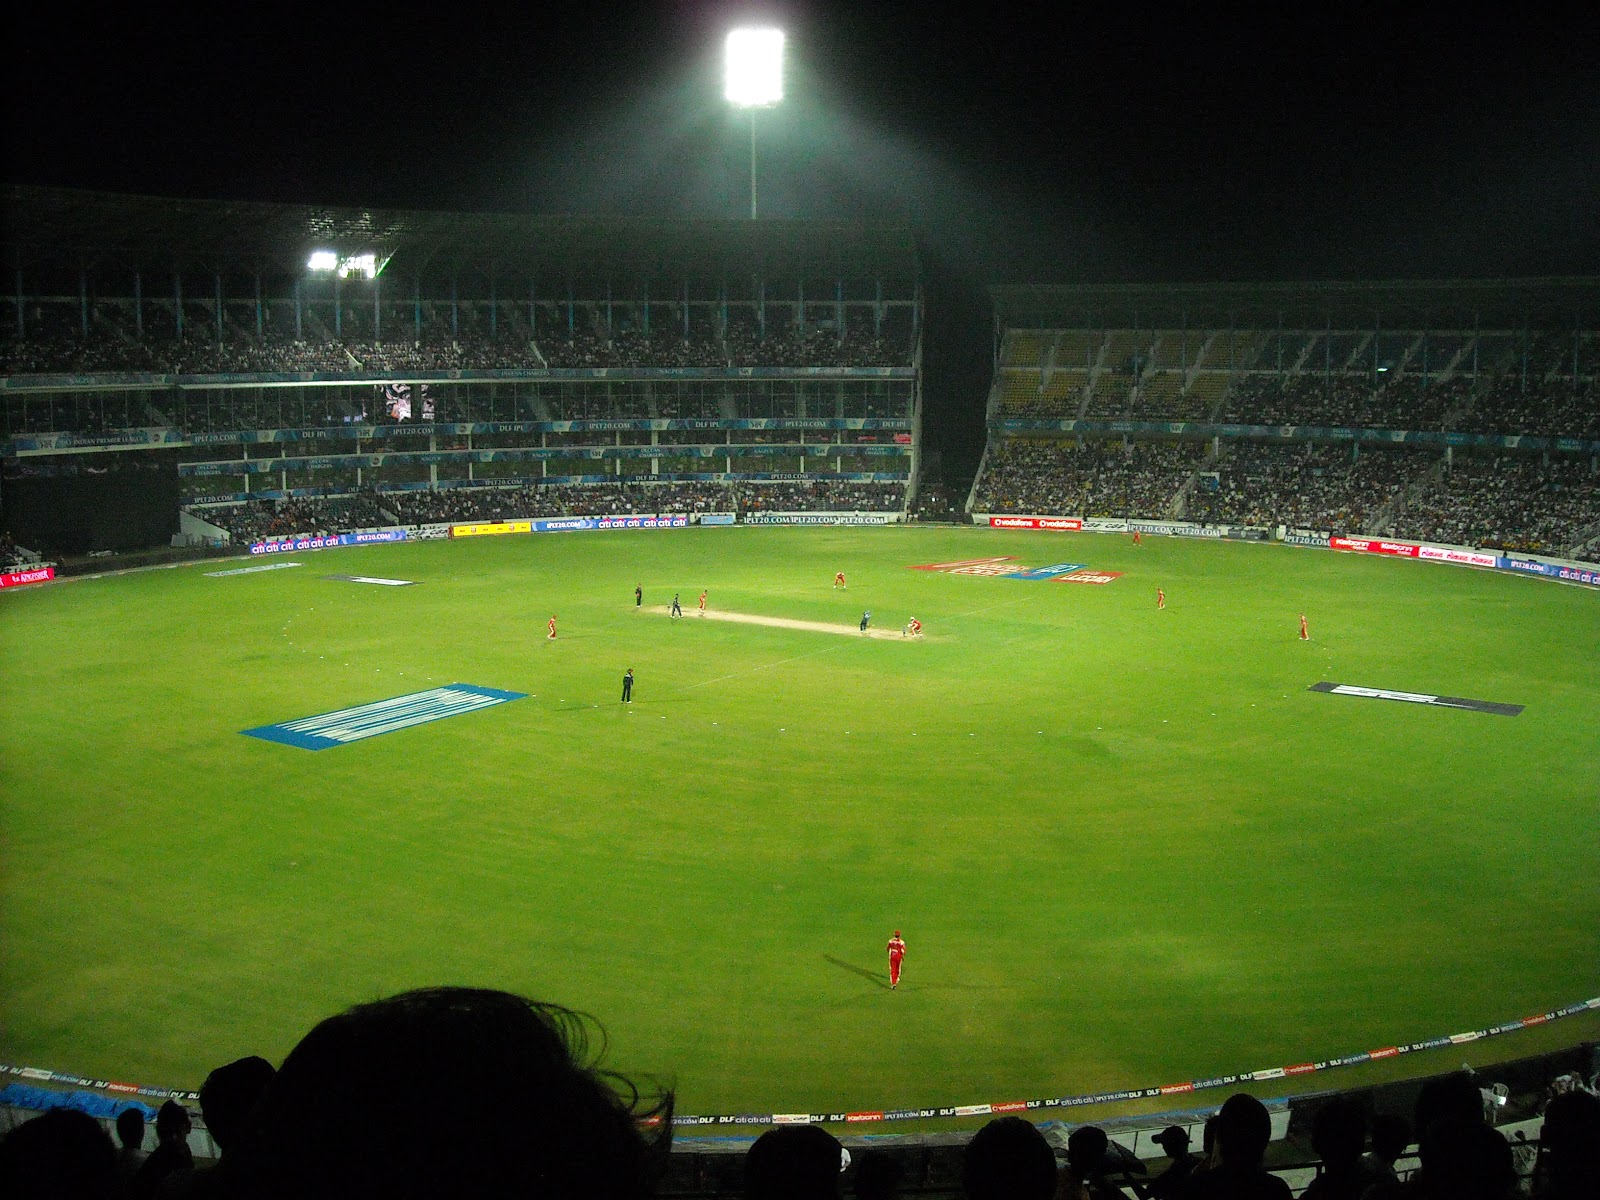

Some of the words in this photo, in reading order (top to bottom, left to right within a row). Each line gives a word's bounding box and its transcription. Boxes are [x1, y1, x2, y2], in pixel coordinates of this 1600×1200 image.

[695, 420, 709, 428] DLF
[598, 518, 611, 528] citi
[612, 517, 625, 528] citi
[626, 517, 640, 527] citi
[643, 517, 657, 527] citi
[658, 517, 671, 527] citi
[673, 517, 686, 526] citi
[744, 517, 791, 525] IPLT20.COM
[252, 543, 266, 554] citi
[266, 542, 280, 553] citi
[280, 540, 294, 551] citi
[297, 538, 311, 549] citi
[311, 537, 324, 548] citi
[325, 536, 339, 547] citi
[1284, 534, 1330, 547] IPLT20.COM
[1559, 568, 1570, 578] citi
[1570, 570, 1581, 581] citi
[1581, 572, 1592, 583] citi
[1397, 1045, 1410, 1054] DLF
[1412, 1042, 1424, 1051] DLF
[1315, 1061, 1327, 1070] DLF
[1329, 1058, 1342, 1067] DLF
[1129, 1091, 1143, 1099] DLF
[1146, 1089, 1160, 1097] DLF
[1193, 1081, 1203, 1089] citi
[1203, 1079, 1213, 1088] citi
[1213, 1078, 1223, 1086] citi
[1223, 1075, 1237, 1084] DLF
[1239, 1073, 1253, 1081] DLF
[1026, 1101, 1041, 1109] DLF
[1045, 1099, 1060, 1107] DLF
[1083, 1096, 1094, 1104] citi
[810, 1114, 826, 1122] DLF
[830, 1114, 845, 1122] DLF
[920, 1109, 936, 1117] DLF
[940, 1108, 955, 1116] DLF
[699, 1116, 715, 1124] DLF
[747, 1116, 759, 1124] citi
